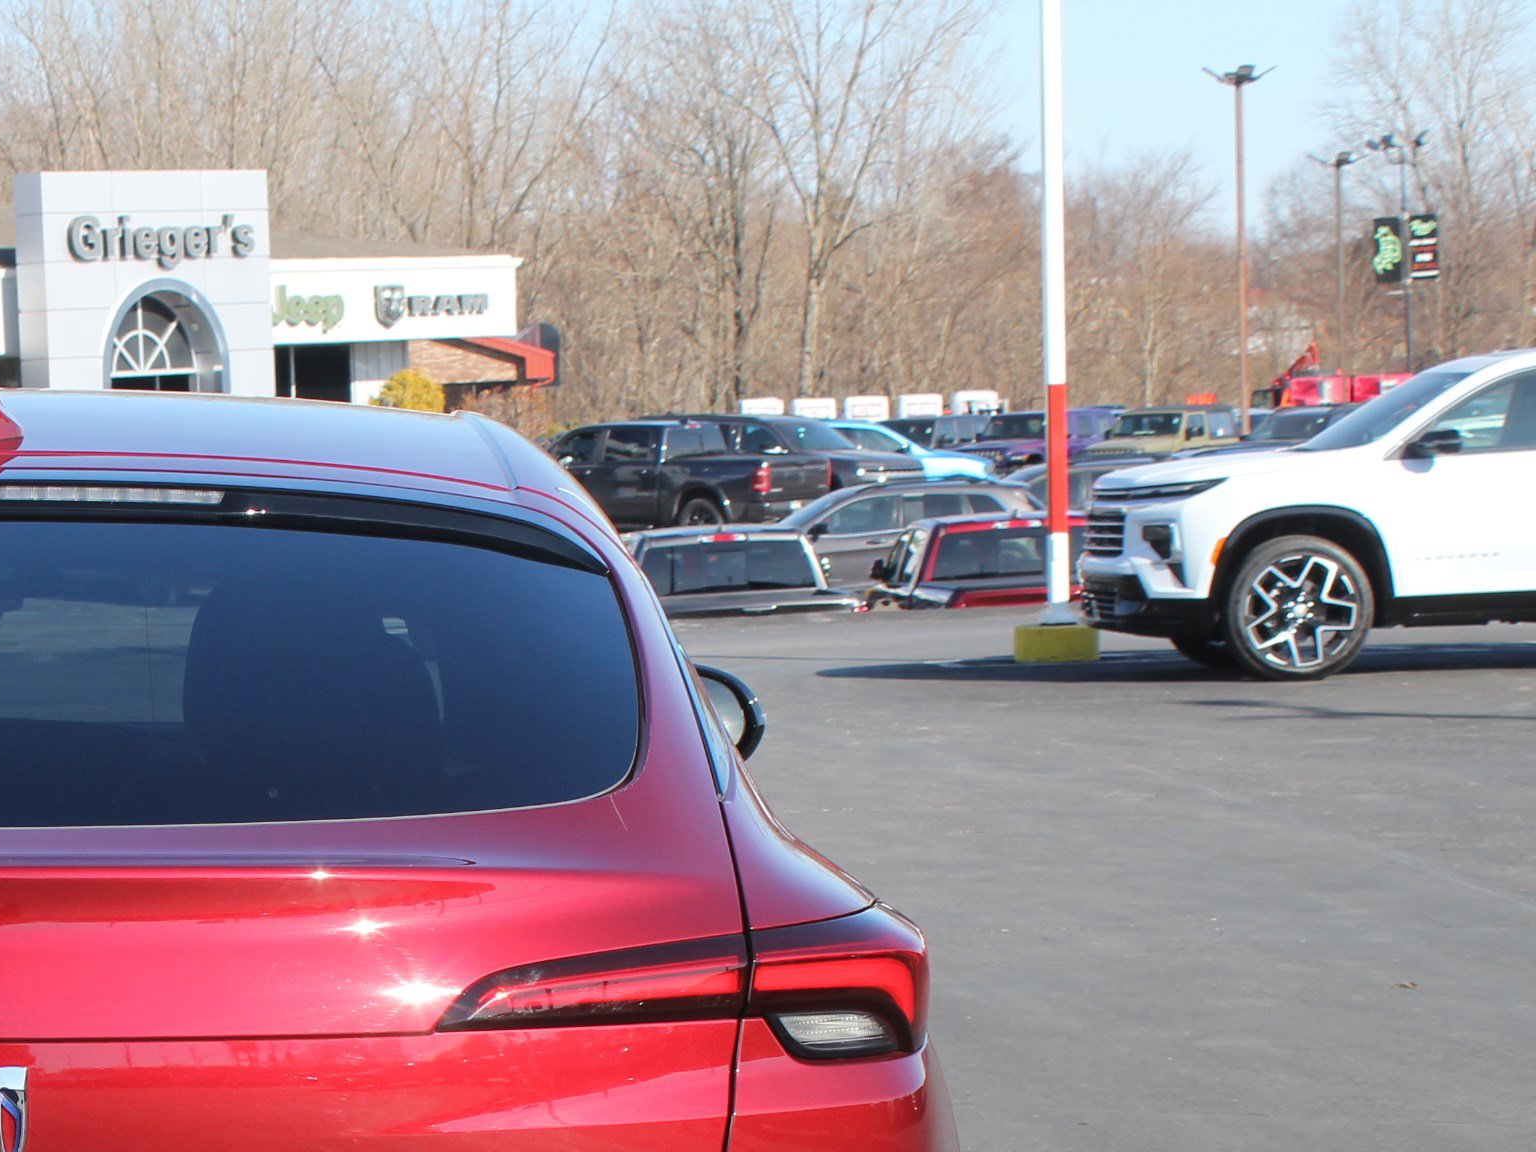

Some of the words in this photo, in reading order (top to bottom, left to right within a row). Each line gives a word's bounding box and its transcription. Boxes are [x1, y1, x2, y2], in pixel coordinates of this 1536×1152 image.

[67, 215, 255, 270] Grieger's
[272, 285, 345, 333] Jeep
[407, 294, 488, 318] RAM
